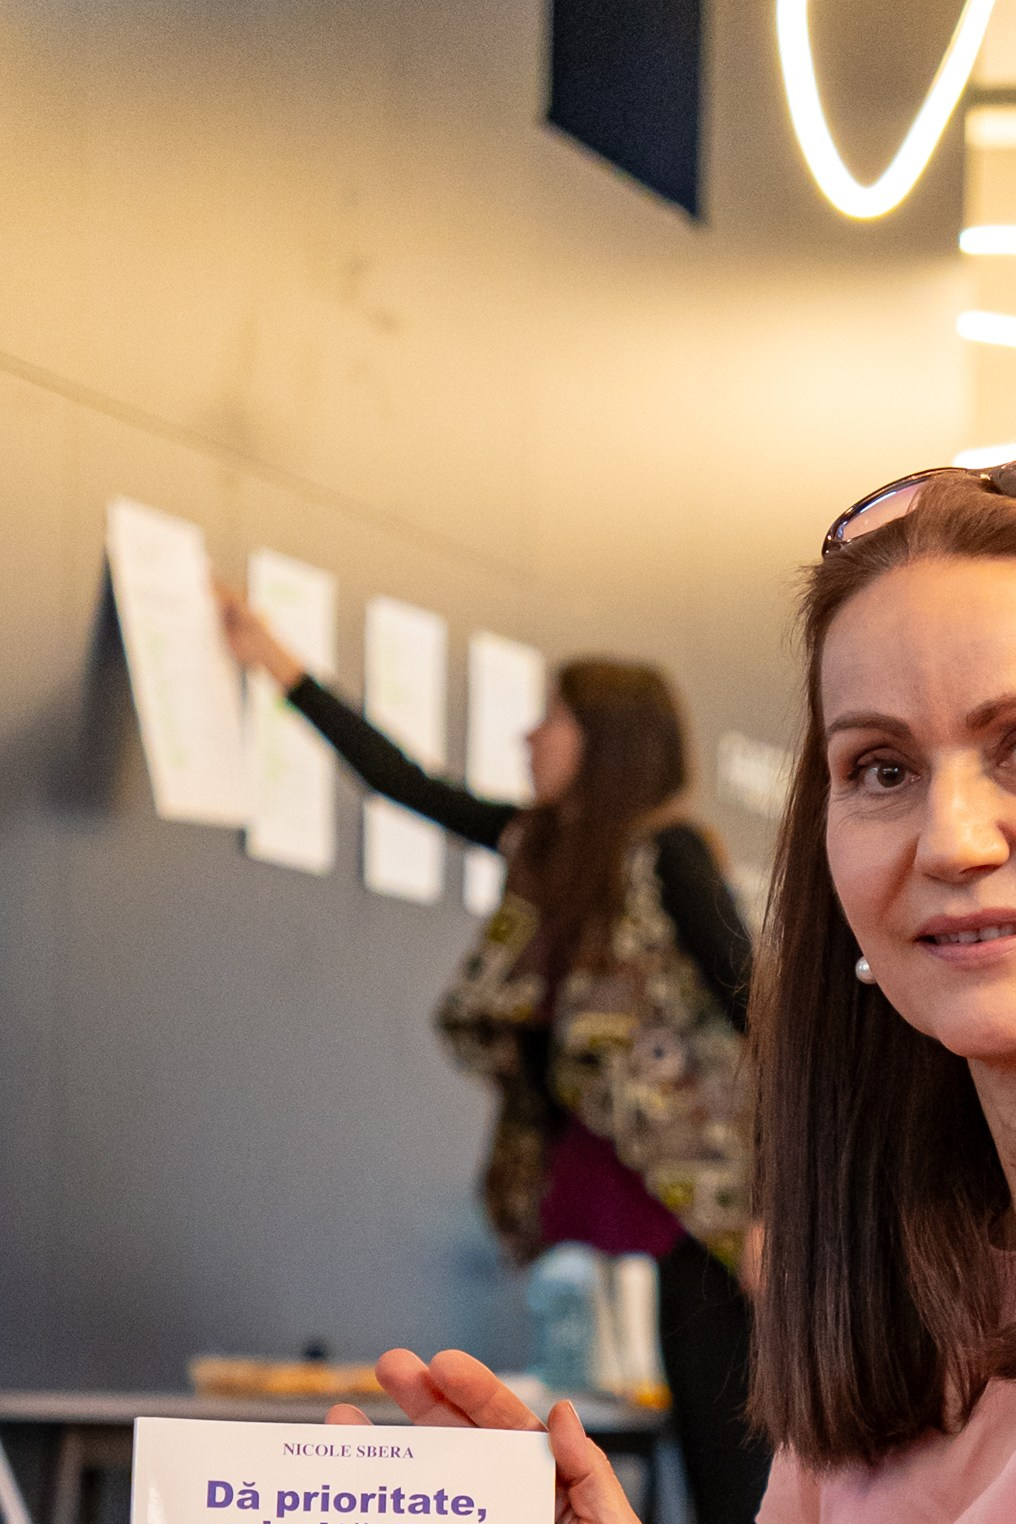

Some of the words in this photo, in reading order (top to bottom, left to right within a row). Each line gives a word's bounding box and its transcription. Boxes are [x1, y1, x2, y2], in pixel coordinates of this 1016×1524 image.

[282, 1443, 352, 1459] NICOLE
[356, 1445, 415, 1460] SBERA
[206, 1480, 261, 1511] Dă
[276, 1484, 488, 1523] prioritate,
